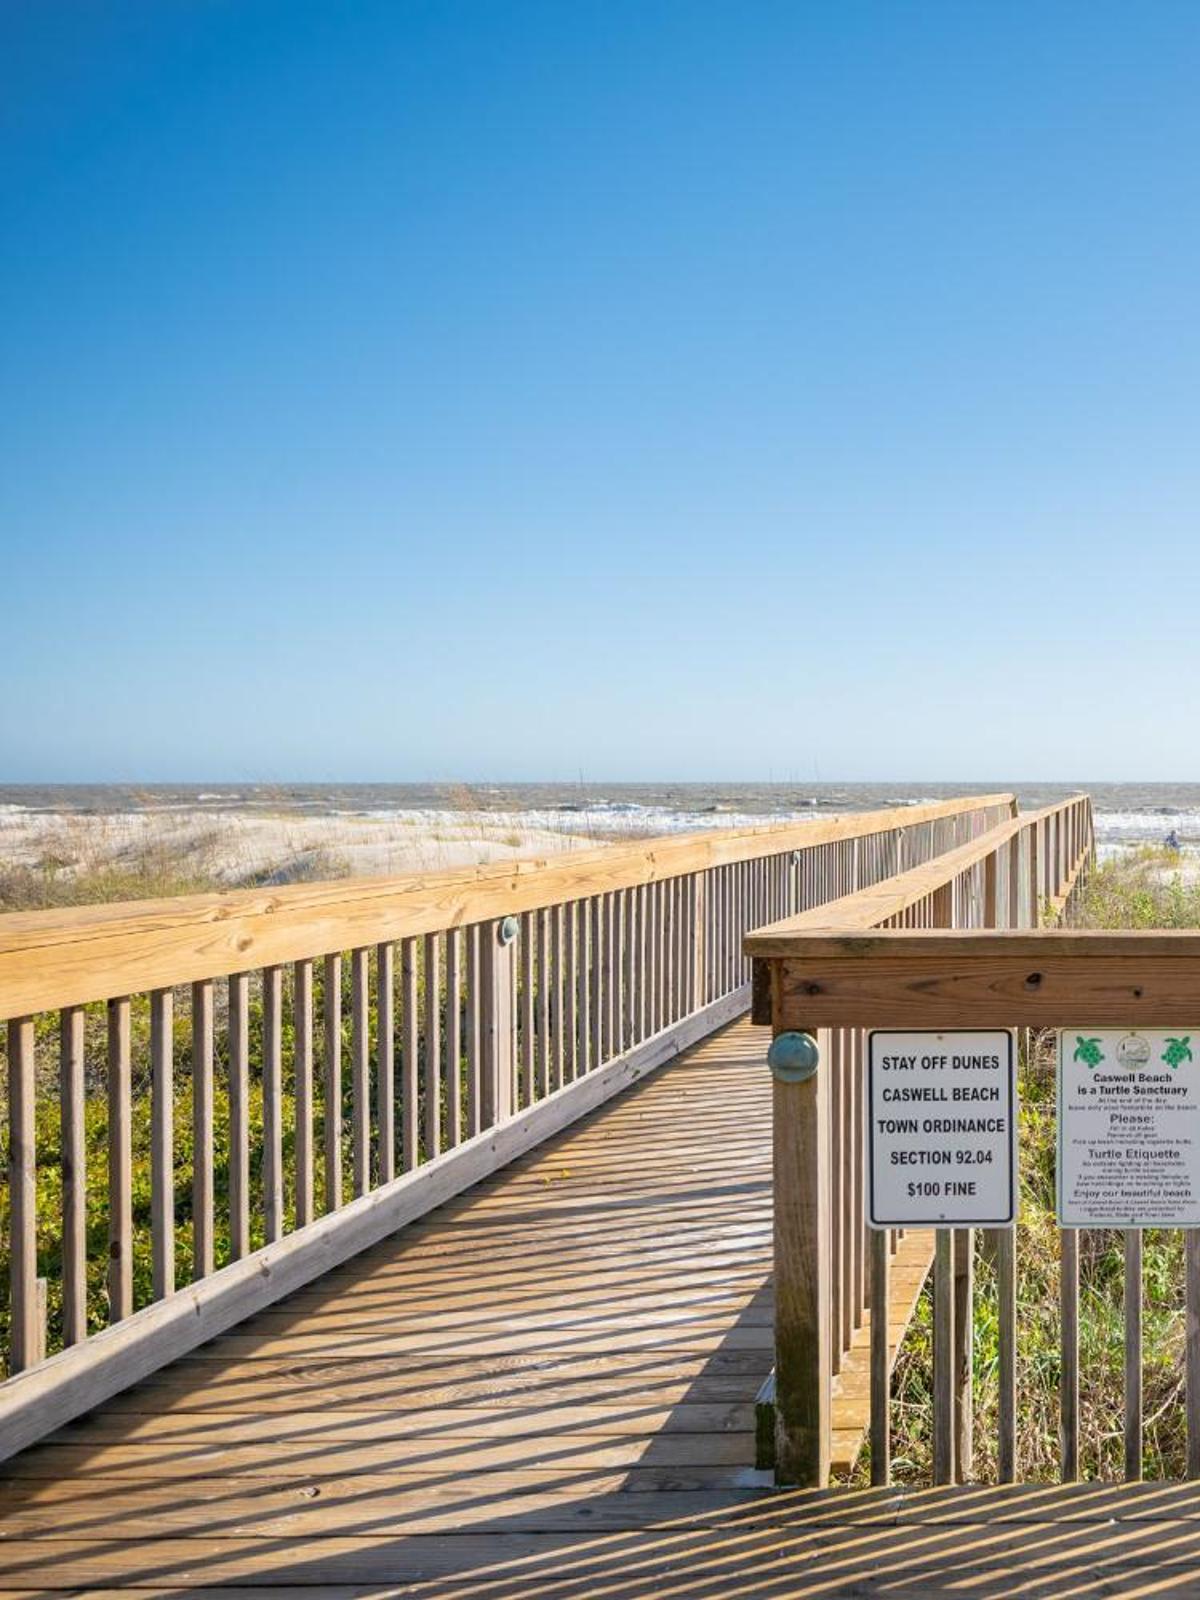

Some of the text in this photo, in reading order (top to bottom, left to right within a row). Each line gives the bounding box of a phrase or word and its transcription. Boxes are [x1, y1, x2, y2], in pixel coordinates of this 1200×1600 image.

[882, 1056, 999, 1070] STAY OFF DUNES
[1094, 1074, 1172, 1082] Caswell Beach
[883, 1088, 999, 1101] CASWELL BEACH
[1078, 1086, 1087, 1095] is
[1100, 1086, 1130, 1095] Turtle
[1133, 1086, 1187, 1097] Sanctuary
[1110, 1114, 1154, 1123] Please:
[878, 1119, 1005, 1133] TOWN ORDINANCE
[891, 1151, 992, 1165] SECTION 92.04
[1089, 1149, 1180, 1160] Turtle Etiquette
[908, 1182, 976, 1196] $100 FINE
[1074, 1190, 1098, 1199] Enjoy
[1121, 1189, 1160, 1197] beautiful
[1164, 1189, 1191, 1197] beach
